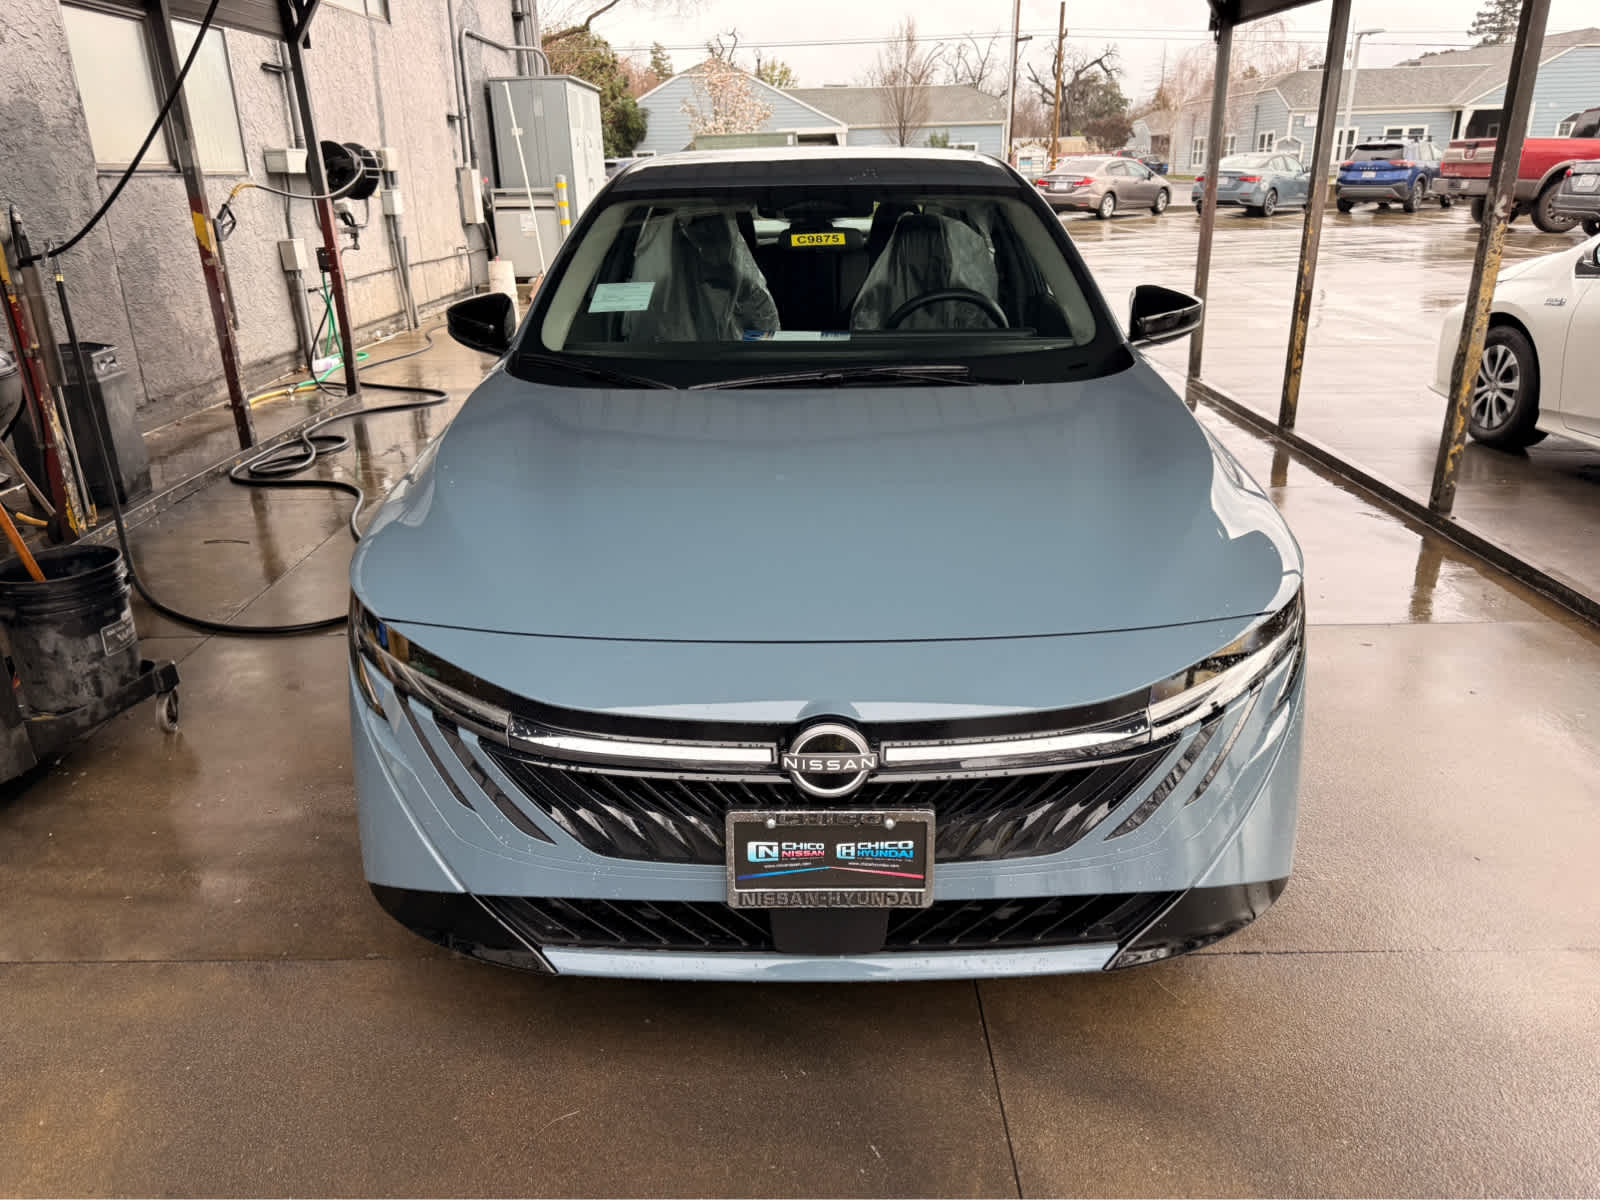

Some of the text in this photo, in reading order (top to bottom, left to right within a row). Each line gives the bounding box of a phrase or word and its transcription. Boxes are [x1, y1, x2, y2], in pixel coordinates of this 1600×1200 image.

[796, 234, 840, 244] C9875
[783, 756, 875, 771] NISSAN
[781, 842, 825, 850] CHICO
[857, 840, 914, 850] CHICO
[857, 849, 914, 859] HYUNDAI
